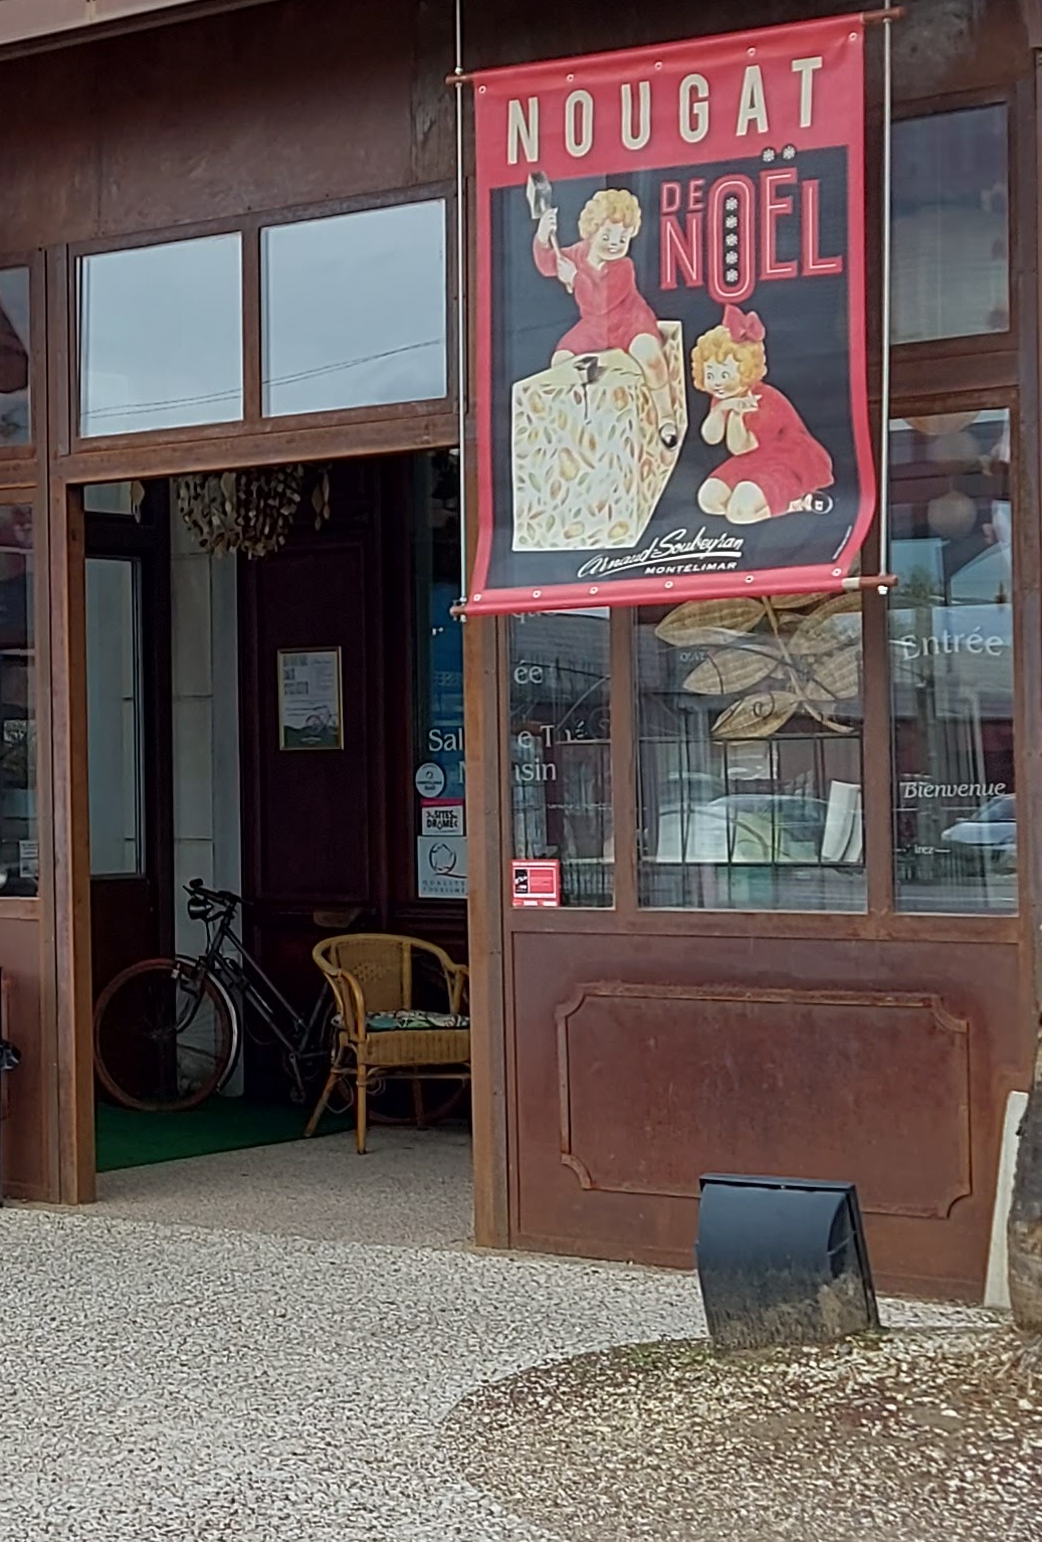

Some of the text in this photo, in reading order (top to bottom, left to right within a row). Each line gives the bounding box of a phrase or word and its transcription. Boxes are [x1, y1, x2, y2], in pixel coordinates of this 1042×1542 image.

[507, 56, 824, 165] NOUGAT
[661, 178, 706, 215] DE
[660, 144, 844, 304] NOËL
[654, 526, 745, 560] Soubeyran
[900, 626, 1005, 660] Entrée
[902, 781, 1007, 799] Bienvenue
